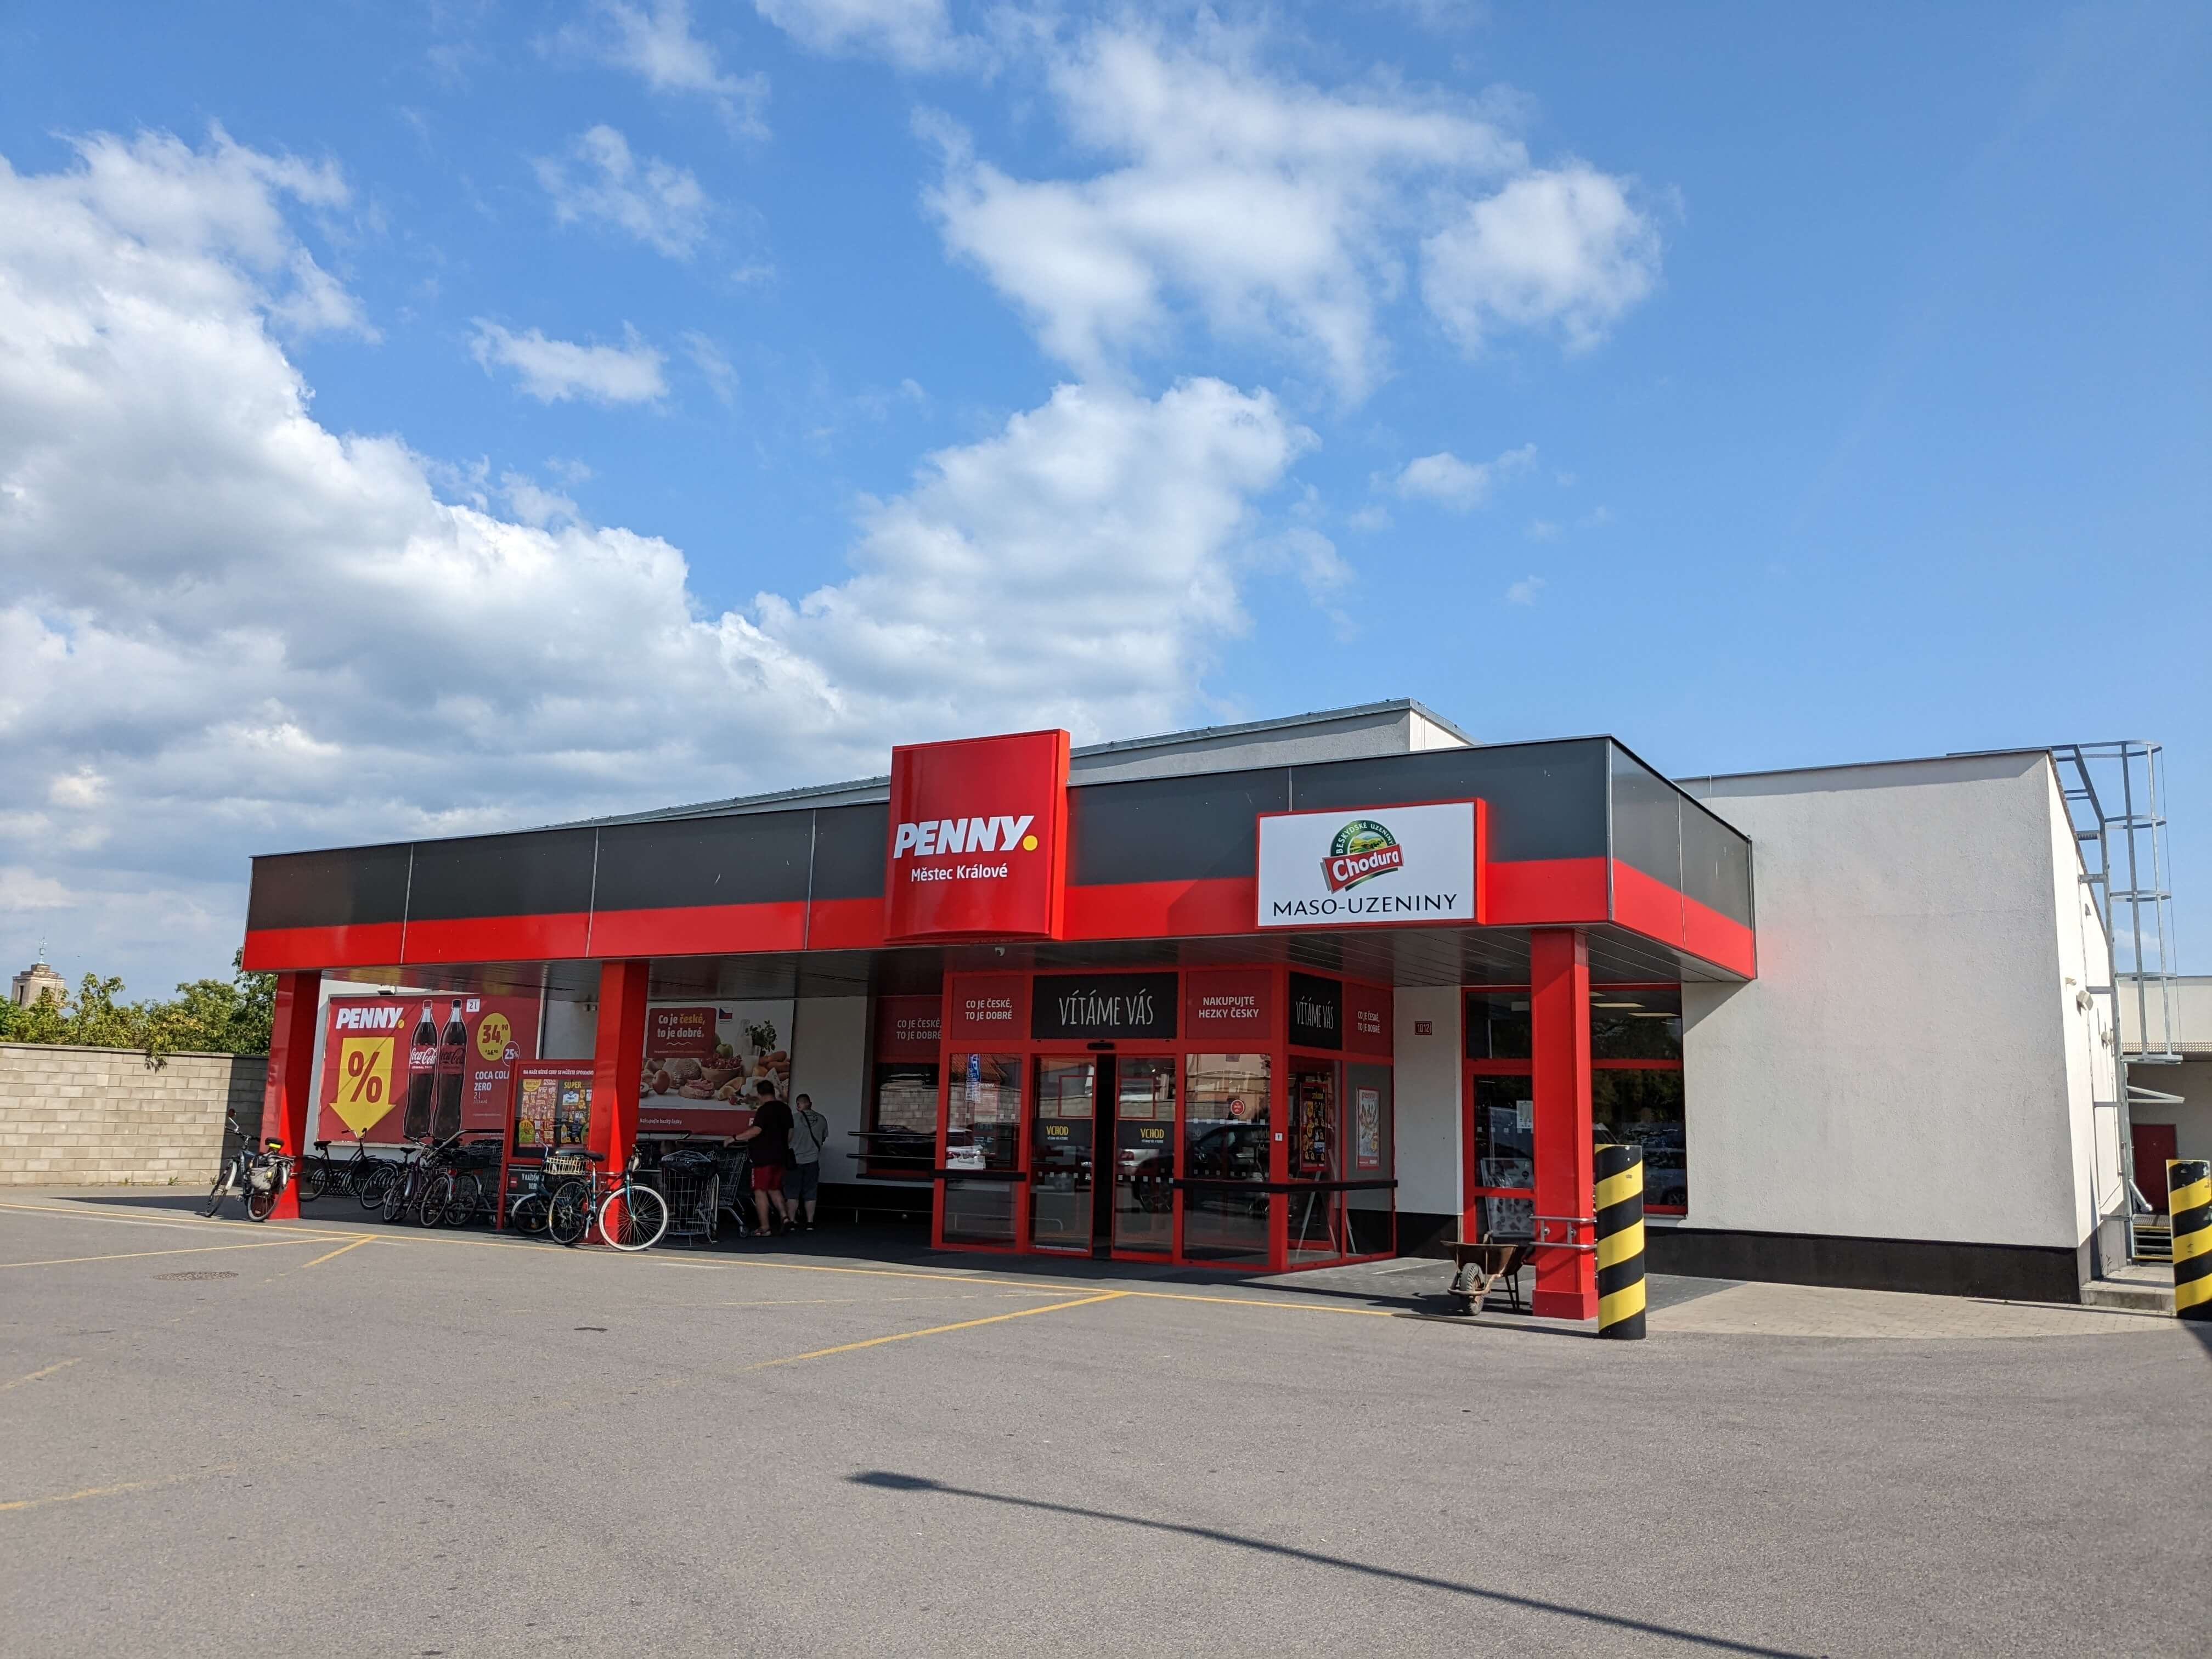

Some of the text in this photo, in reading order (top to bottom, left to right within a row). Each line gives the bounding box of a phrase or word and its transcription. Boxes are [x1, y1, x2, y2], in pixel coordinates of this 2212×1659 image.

[1336, 822, 1394, 854] BESKYDSKÉ UZENINY
[911, 862, 1008, 882] Městec Králové
[1333, 851, 1400, 882] Chodura
[1273, 893, 1457, 917] MASO-UZENINY
[966, 998, 1012, 1009] CO JE ČESKÉ,
[1059, 988, 1153, 1026] VÍTÁME VÁS
[1203, 996, 1255, 1007] NAKUPUJTE
[976, 1011, 984, 1021] JE
[986, 1009, 1012, 1019] DOBRÉ
[1199, 1007, 1259, 1018] HEZKY ČESKY
[1296, 996, 1334, 1029] VÍTÁME VÁS
[1358, 1011, 1363, 1019] CO
[1363, 1011, 1367, 1020] JE
[658, 1013, 705, 1026] Co je české,
[908, 1020, 915, 1029] JE
[1358, 1023, 1380, 1034] TO JE DOBRÉ
[1418, 1023, 1430, 1032] 1012
[657, 1027, 704, 1040] to je dobré.
[907, 1031, 915, 1040] JE
[917, 1029, 942, 1039] DOBRÉ
[348, 1051, 382, 1103] %
[475, 1071, 493, 1080] COCA
[474, 1082, 492, 1091] ZERO
[1046, 1126, 1069, 1136] VCHOD
[1140, 1128, 1164, 1138] VCHOD
